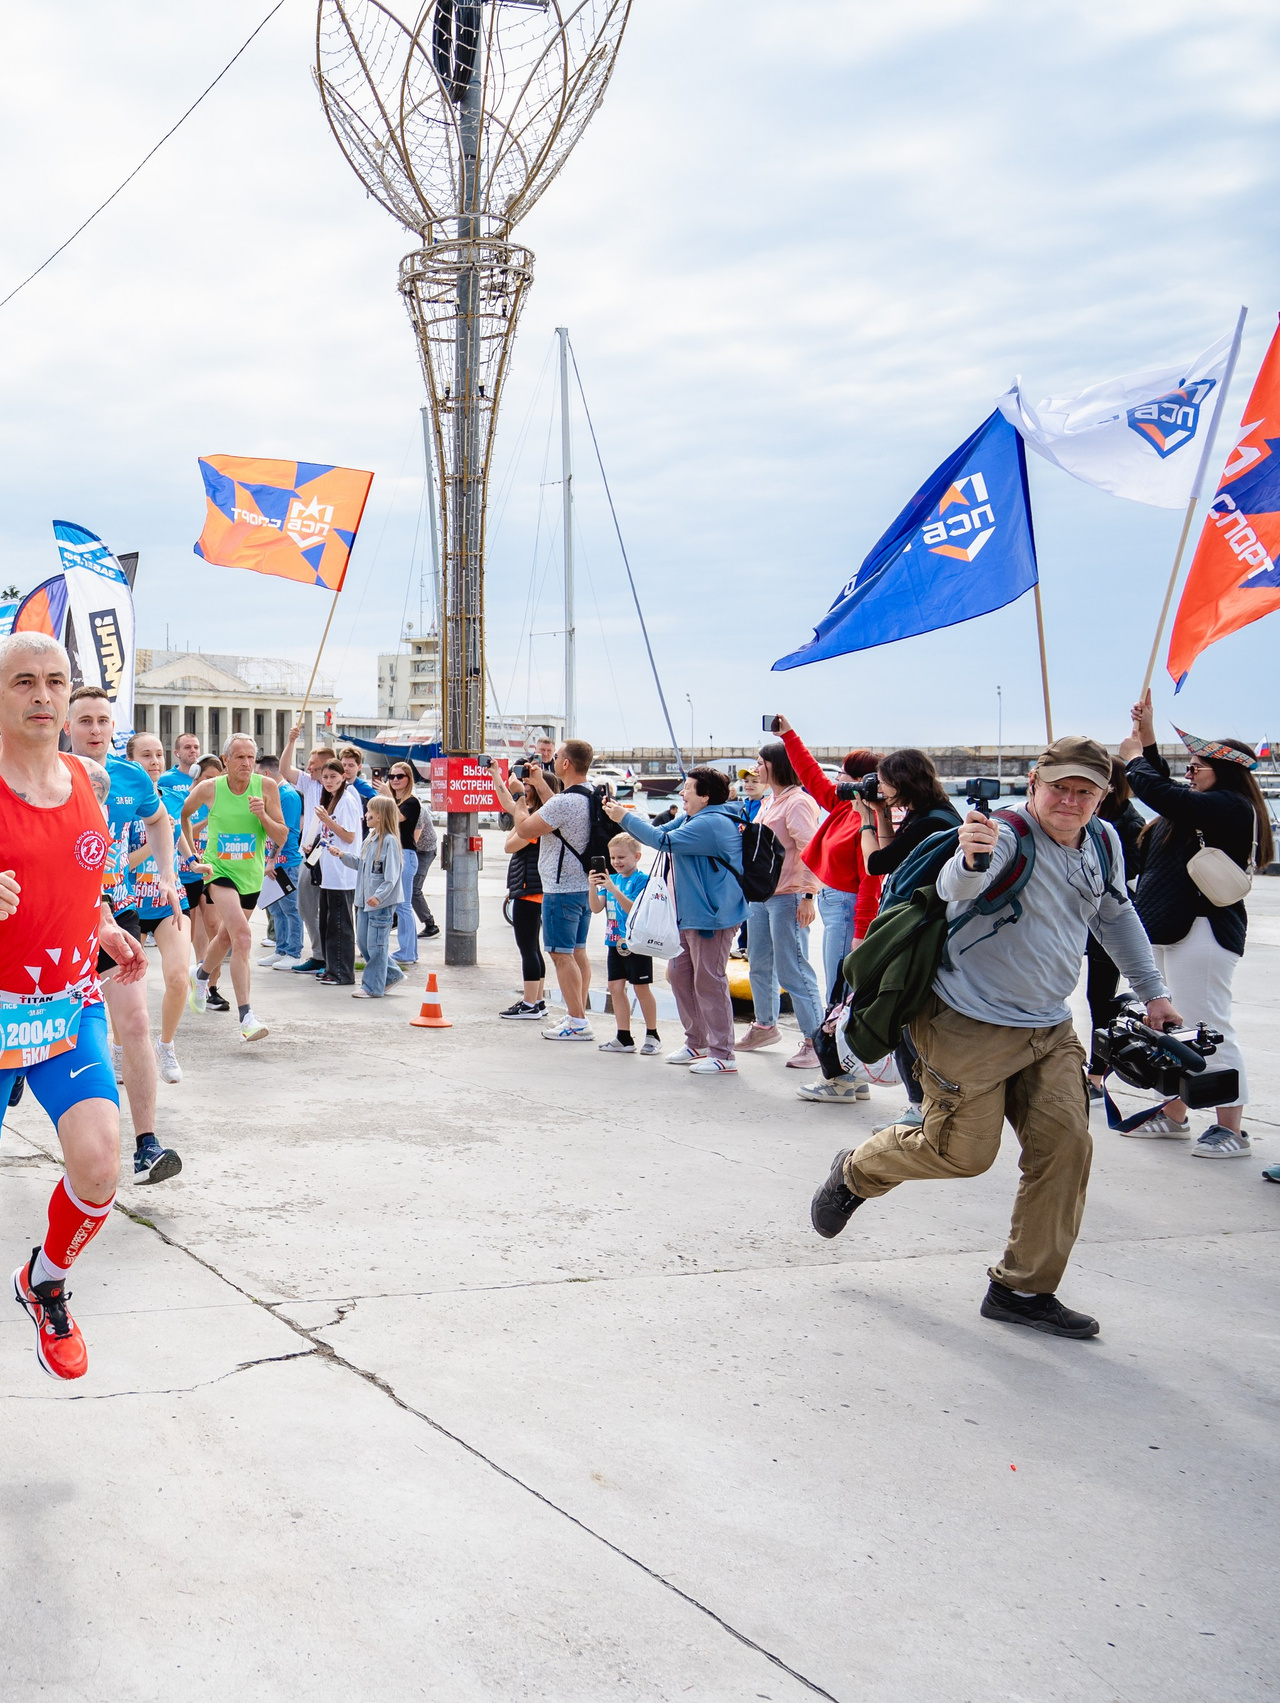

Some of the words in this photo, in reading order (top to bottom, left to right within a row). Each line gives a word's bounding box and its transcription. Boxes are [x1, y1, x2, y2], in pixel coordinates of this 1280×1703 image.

[1208, 493, 1275, 580] СПОРТ
[463, 765, 502, 776] ВЫЗО
[449, 779, 507, 791] ЭКСТРЕНН
[463, 794, 494, 805] СЛУЖБ
[19, 995, 54, 1004] TITAN
[6, 1018, 66, 1047] 20043
[22, 1045, 51, 1067] 5KM
